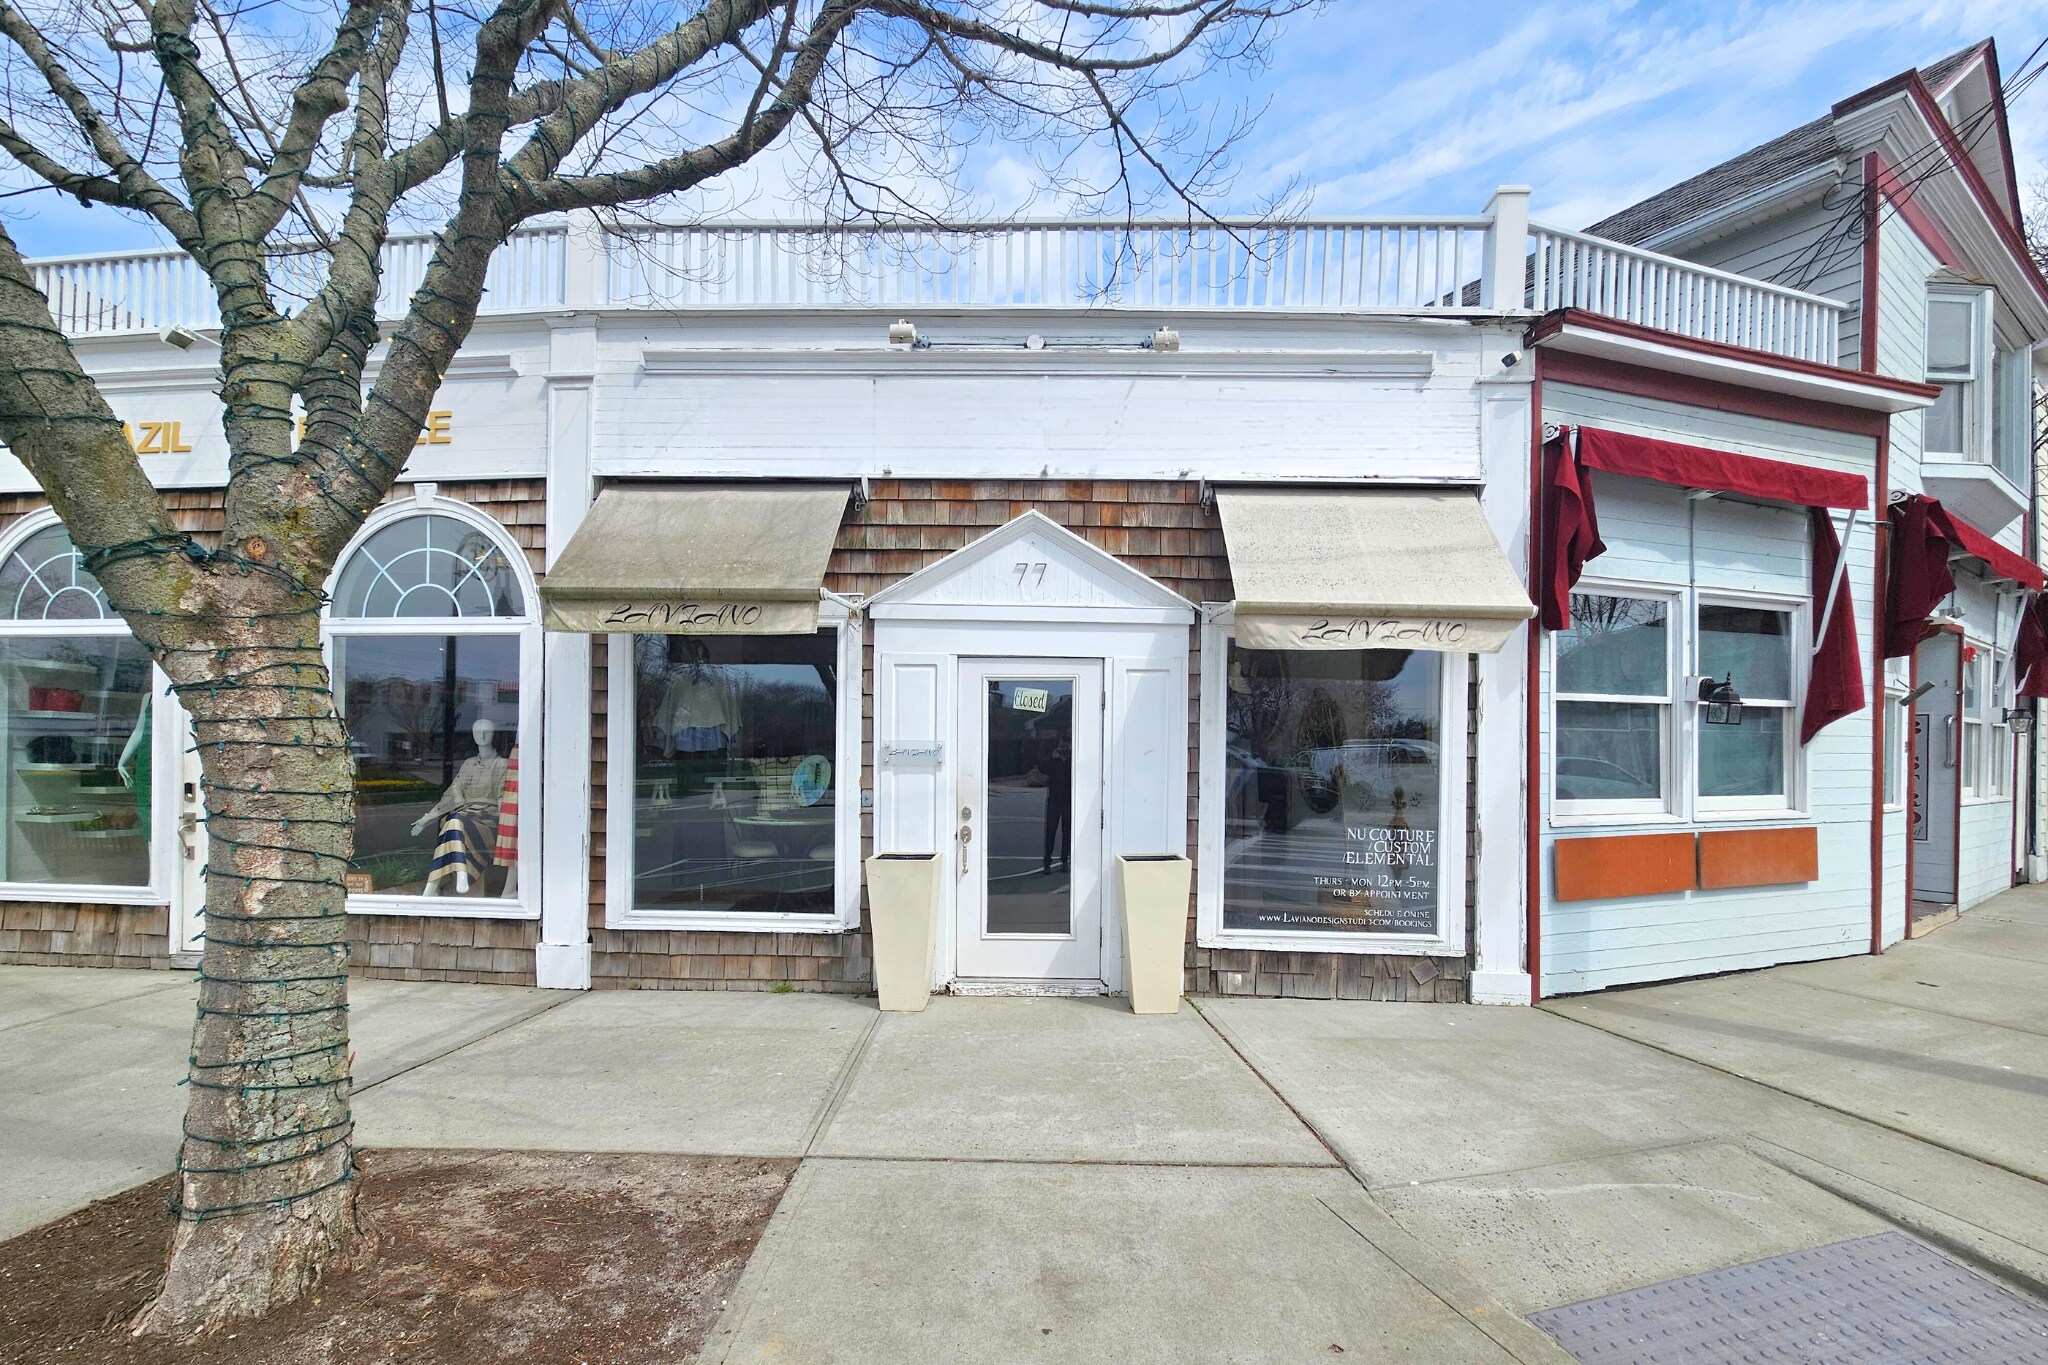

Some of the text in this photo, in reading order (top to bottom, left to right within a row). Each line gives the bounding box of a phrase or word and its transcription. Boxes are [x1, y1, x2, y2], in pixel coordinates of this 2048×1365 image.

[1016, 562, 1047, 588] 77
[604, 603, 762, 626] LAVIANO
[1301, 619, 1467, 642] LAVIANO
[1015, 689, 1045, 710] Closed
[1347, 827, 1435, 843] NU COUTURE
[1313, 876, 1342, 886] THURS
[1352, 878, 1372, 887] MON
[1333, 888, 1346, 897] OR
[1349, 889, 1361, 897] BY
